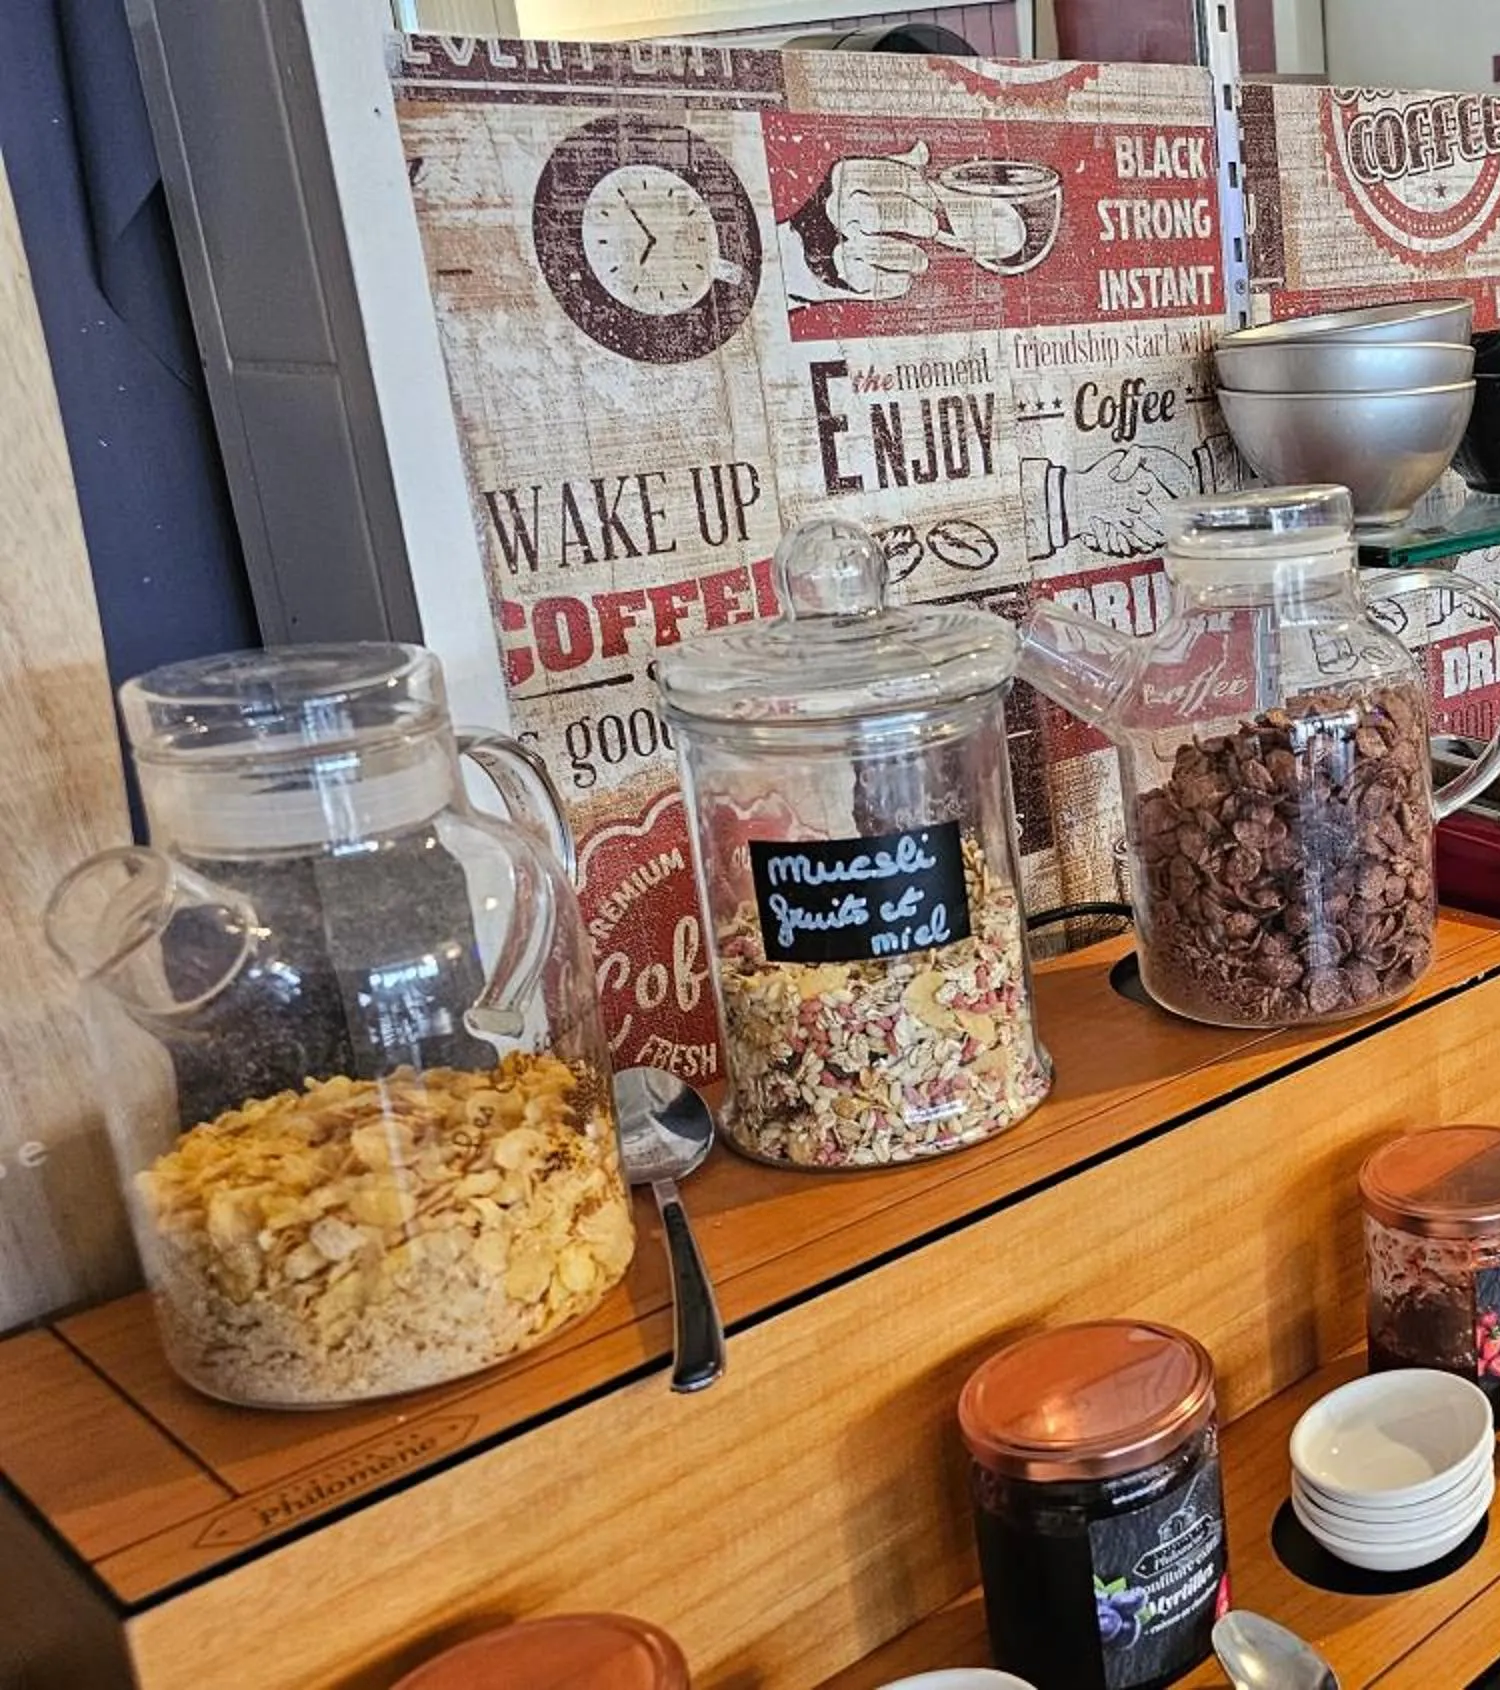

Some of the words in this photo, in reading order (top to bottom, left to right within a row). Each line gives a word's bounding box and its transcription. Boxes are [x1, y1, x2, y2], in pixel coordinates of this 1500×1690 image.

[1115, 135, 1207, 179] BLACK
[1096, 198, 1212, 241] STRONG
[1098, 265, 1215, 311] INSTANT
[852, 364, 896, 394] the
[896, 347, 995, 391] moment
[1014, 328, 1119, 369] friendship
[1126, 323, 1176, 360] start
[809, 359, 995, 497] ENJOY
[1074, 377, 1176, 443] Coffee
[483, 471, 677, 575] WAKE
[690, 461, 762, 547] UP
[590, 847, 686, 958] REMIUM
[769, 892, 870, 948] fruits
[879, 885, 926, 923] et
[870, 902, 951, 956] miel
[636, 1034, 718, 1078] FRESH
